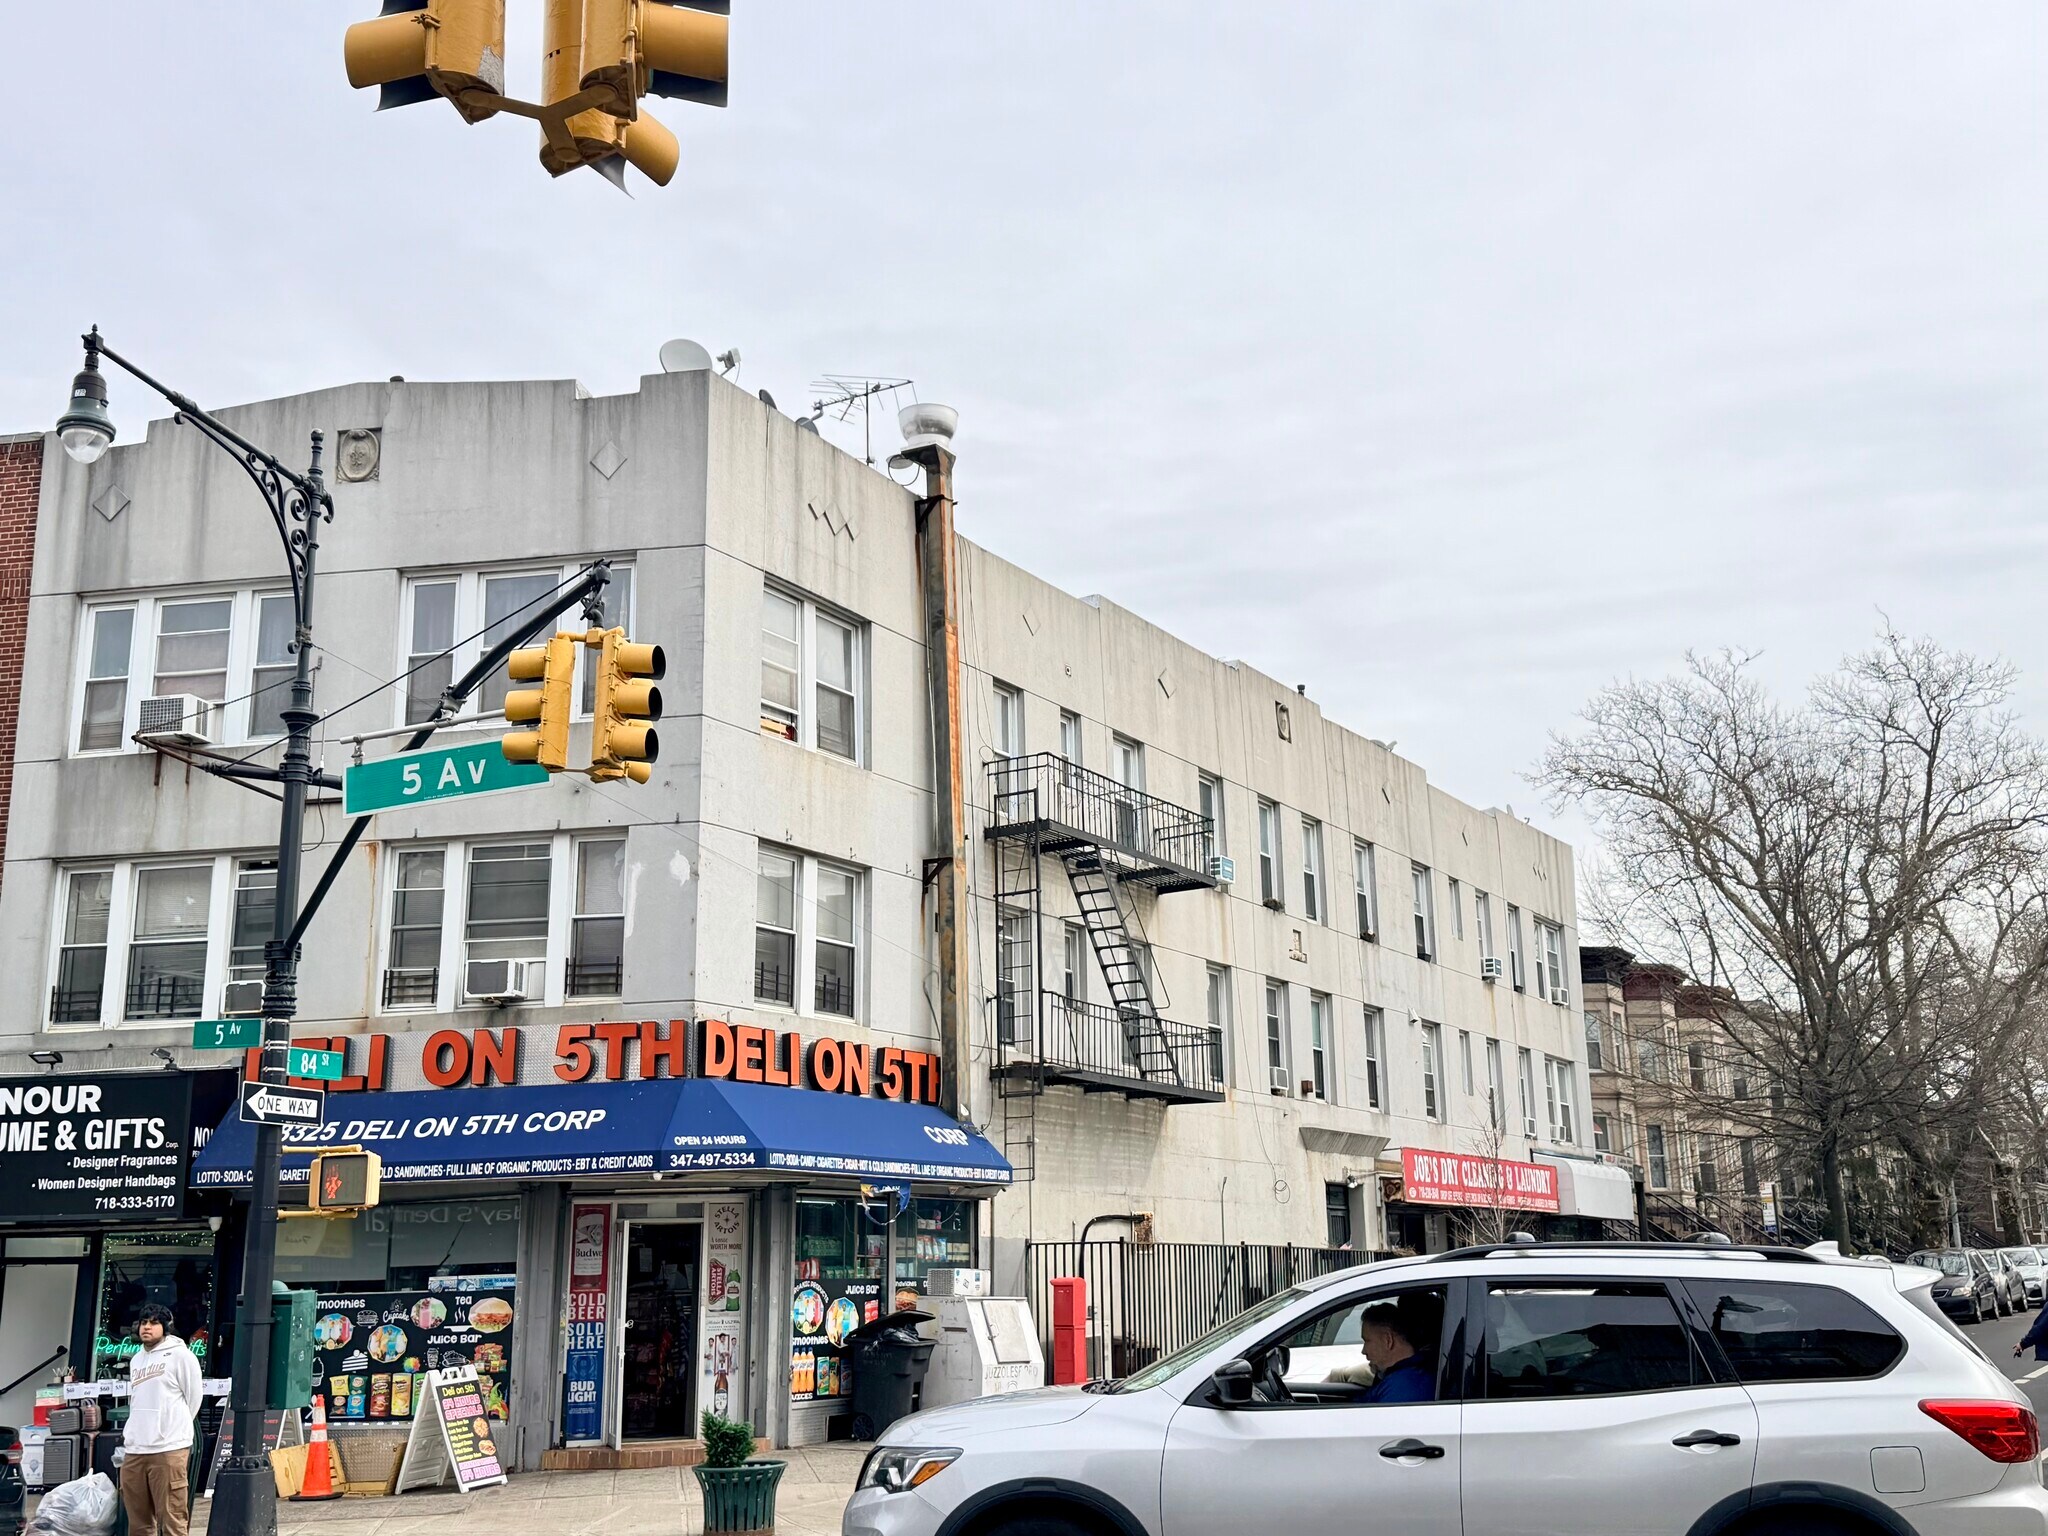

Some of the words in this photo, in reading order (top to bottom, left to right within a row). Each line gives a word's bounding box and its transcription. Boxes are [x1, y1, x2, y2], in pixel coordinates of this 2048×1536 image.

[402, 763, 422, 796] 5
[437, 757, 487, 790] Av
[214, 1024, 224, 1045] 5
[229, 1022, 242, 1035] Av
[421, 1027, 519, 1087] ON
[553, 1019, 688, 1082] 5TH
[703, 1020, 801, 1087] DELI
[811, 1037, 870, 1095] ON
[301, 1053, 317, 1074] 84
[321, 1053, 330, 1066] St
[0, 1085, 102, 1115] NOUR
[258, 1096, 281, 1112] ONE
[288, 1099, 312, 1115] WAY
[341, 1118, 409, 1141] DELI
[413, 1115, 459, 1138] ON
[461, 1113, 519, 1136] 5TH
[523, 1109, 607, 1133] CORP
[54, 1120, 77, 1150] &
[85, 1117, 165, 1150] GIFTS
[194, 1126, 213, 1148] NO
[674, 1135, 701, 1146] OPEN
[702, 1135, 713, 1145] 24
[714, 1135, 747, 1145] HOURS
[923, 1125, 969, 1146] CORP
[73, 1156, 118, 1170] Designer
[120, 1155, 177, 1168] Fragrances
[466, 1162, 483, 1175] LINE
[484, 1162, 495, 1174] OF
[496, 1160, 531, 1174] ORGANIC
[592, 1157, 597, 1168] &
[599, 1155, 626, 1169] CREDIT
[628, 1154, 653, 1167] CARDS
[670, 1153, 755, 1167] 347-497-5334
[1414, 1154, 1438, 1183] JOE'S
[1440, 1157, 1459, 1186] DRY
[1514, 1165, 1551, 1194] LAUNDRY
[38, 1178, 75, 1190] Women
[77, 1176, 122, 1190] Designer
[125, 1174, 176, 1189] Handbags
[95, 1195, 175, 1209] 718-333-5170
[714, 1205, 739, 1218] STELLA
[714, 1221, 740, 1235] ARTOIS
[845, 1285, 864, 1295] Juice
[866, 1284, 880, 1294] Bar
[316, 1298, 365, 1309] moothies
[455, 1295, 472, 1305] Tea
[569, 1292, 605, 1307] COLD
[382, 1310, 409, 1323] Cupcake
[568, 1306, 605, 1320] BEER
[567, 1322, 604, 1336] SOLD
[427, 1334, 458, 1345] Juice
[460, 1333, 482, 1344] Bar
[566, 1336, 604, 1350] HERE
[442, 1386, 455, 1397] Deli
[456, 1386, 464, 1395] on
[465, 1383, 475, 1393] 5th
[570, 1380, 595, 1392] BUD
[567, 1390, 597, 1403] LIGHT
